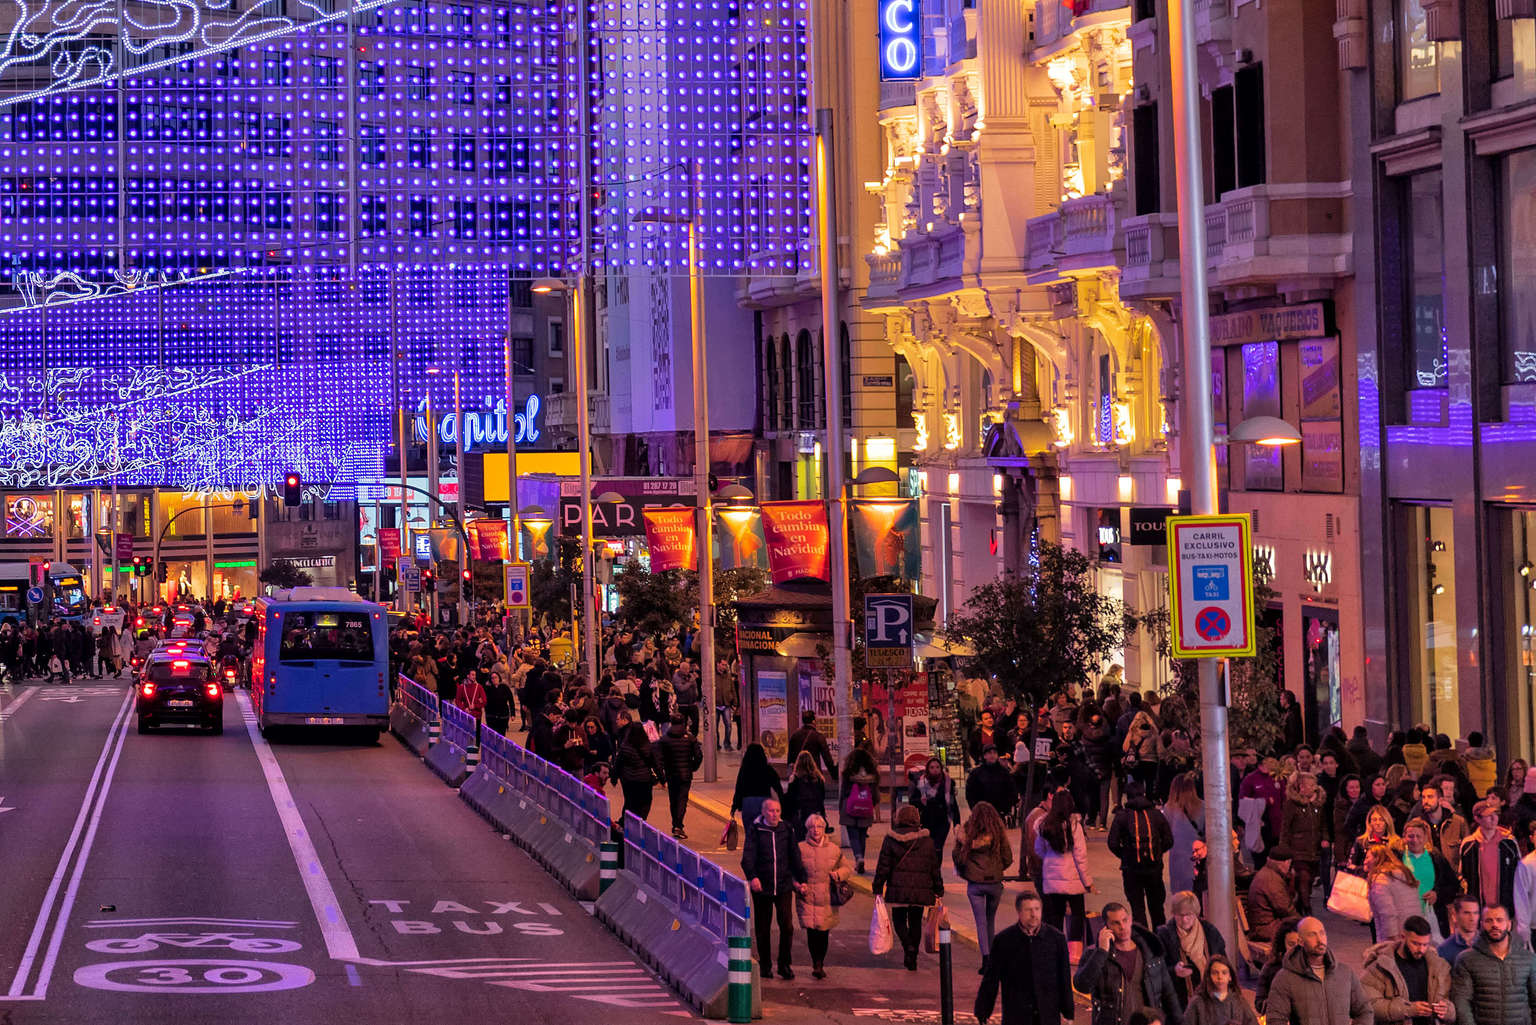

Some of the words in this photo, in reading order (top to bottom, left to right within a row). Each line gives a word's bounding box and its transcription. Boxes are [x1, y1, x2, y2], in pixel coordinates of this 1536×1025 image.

[776, 510, 812, 521] Todo
[790, 535, 806, 543] en
[1192, 532, 1225, 540] CARRIL
[1183, 541, 1235, 550] EXCLUSIVO
[869, 605, 910, 642] P
[368, 899, 564, 916] TAXI
[391, 920, 565, 936] BUS
[135, 966, 264, 985] 30
